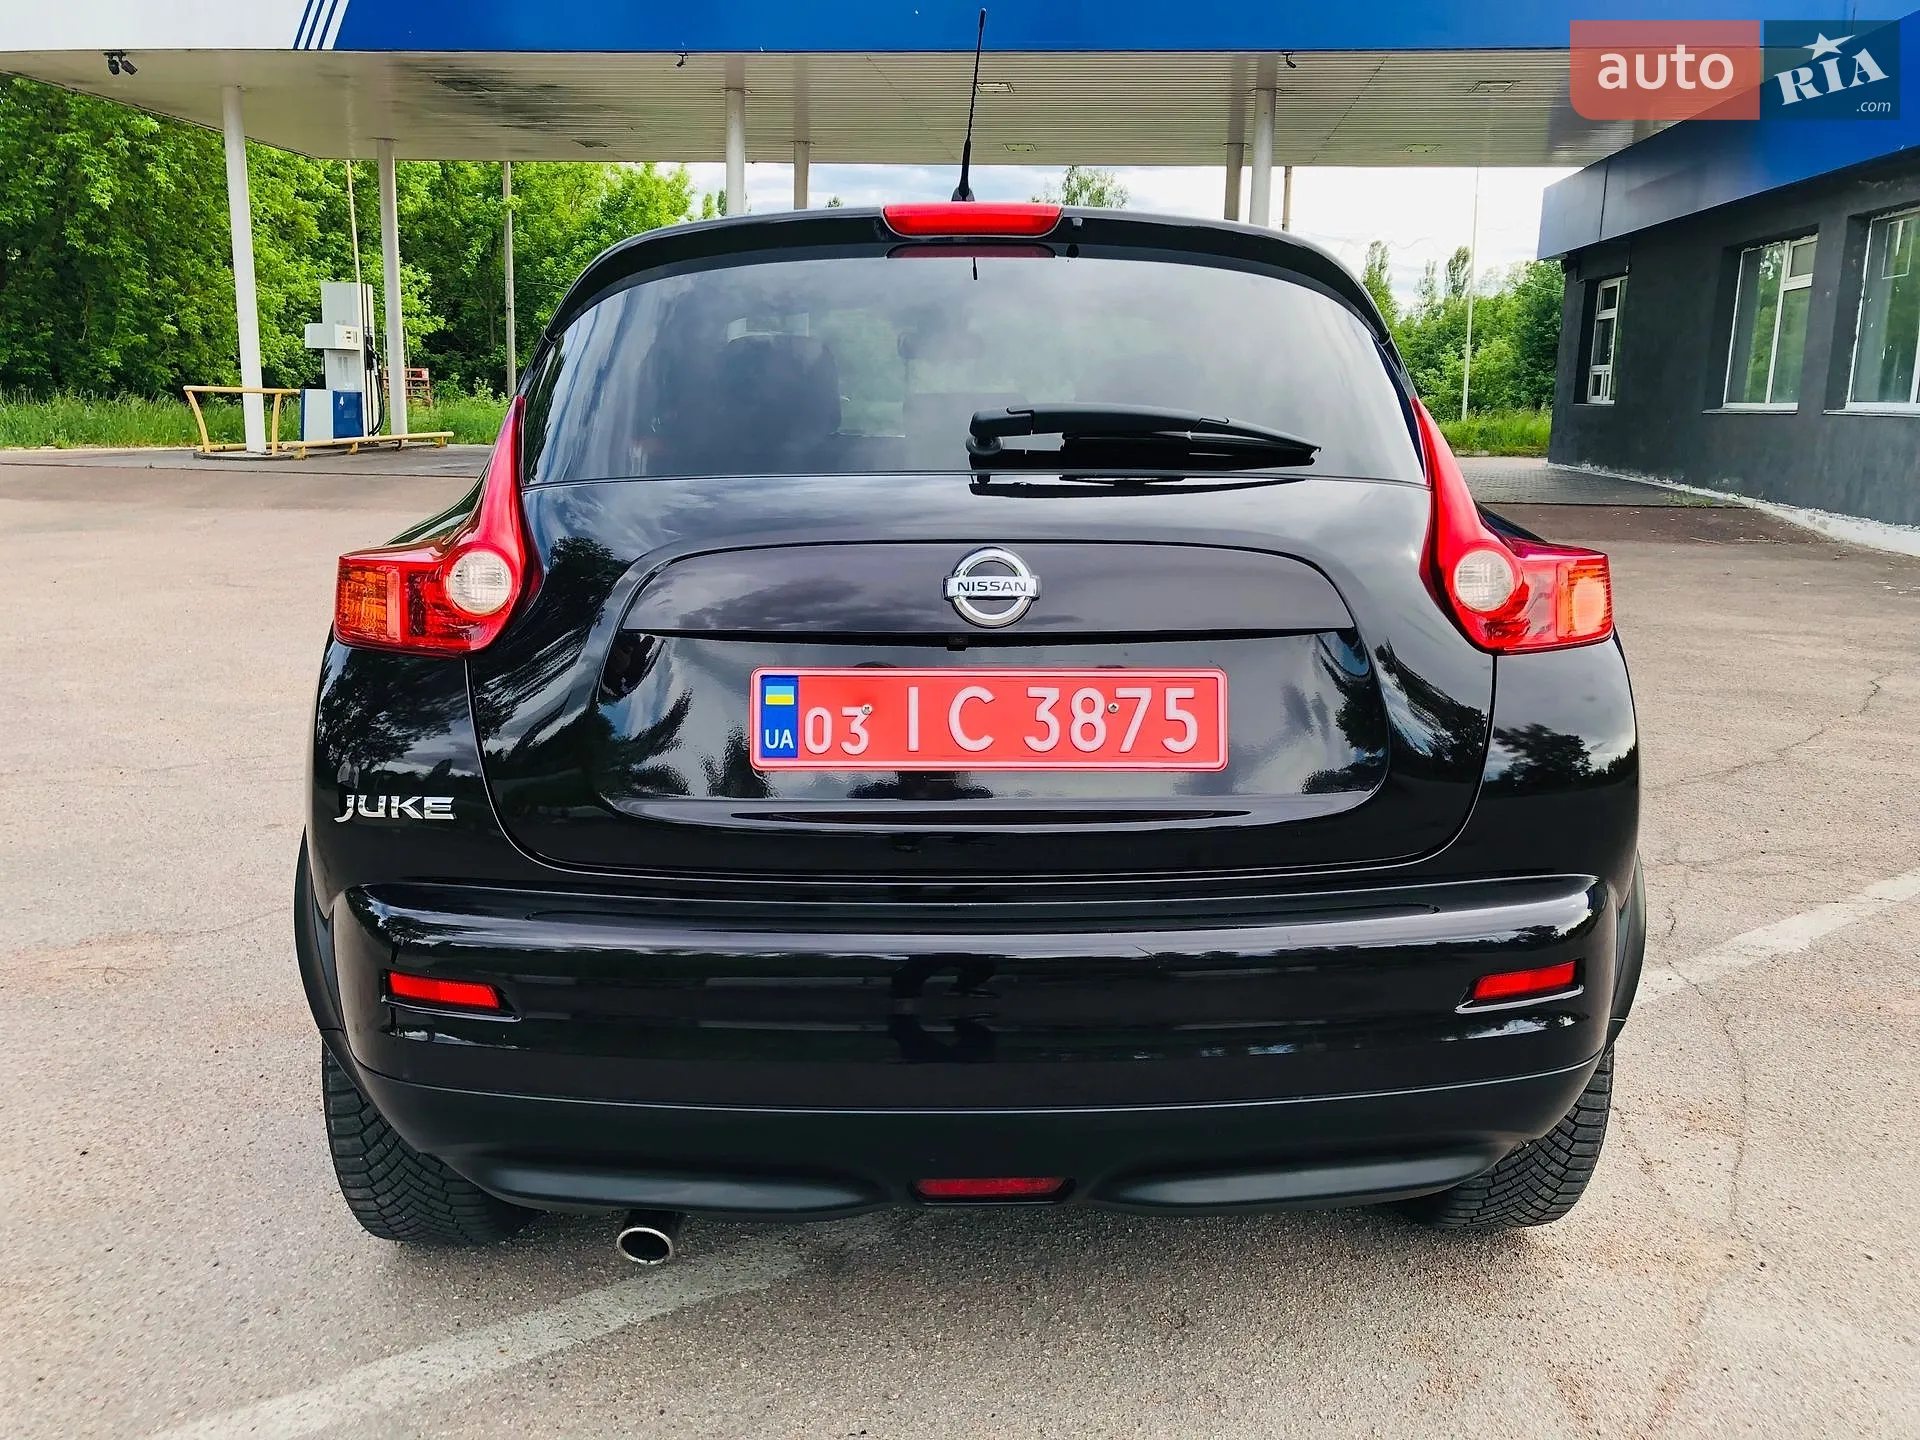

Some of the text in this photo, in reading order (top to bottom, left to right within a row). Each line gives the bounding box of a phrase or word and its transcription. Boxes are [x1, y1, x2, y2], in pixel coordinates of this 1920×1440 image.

[957, 581, 1027, 592] NISSAN
[803, 705, 871, 756] 03
[1023, 687, 1199, 754] 3875
[764, 728, 795, 750] UA
[333, 794, 455, 823] JUKE
